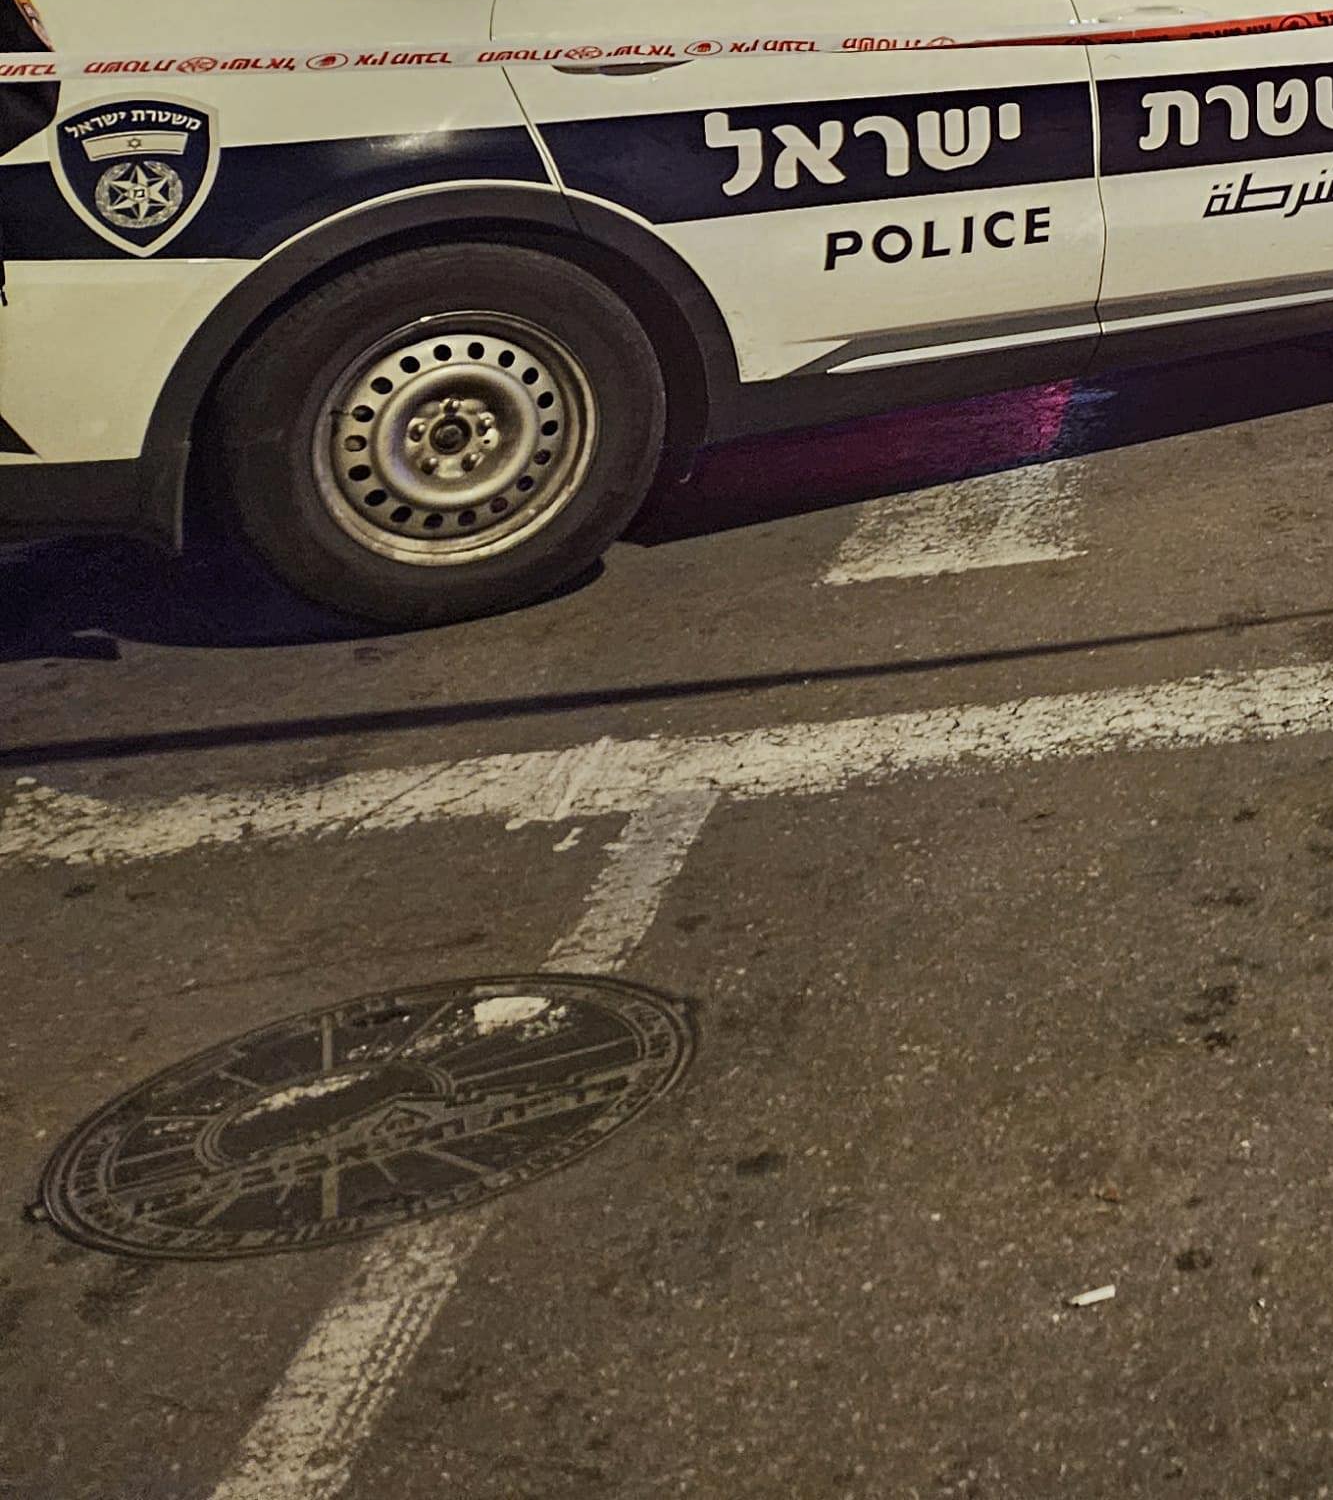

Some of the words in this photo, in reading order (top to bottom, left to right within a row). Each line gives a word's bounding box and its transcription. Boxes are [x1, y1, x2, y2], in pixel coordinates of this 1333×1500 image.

[83, 59, 177, 74] משטרת
[220, 57, 296, 71] ישראל
[353, 51, 390, 67] אין
[390, 51, 452, 65] מעבר
[476, 49, 563, 64] משטרת
[606, 45, 676, 59] ישראל
[728, 39, 758, 53] אין
[762, 40, 821, 52] מעבר
[64, 110, 127, 139] ישראל
[130, 108, 202, 131] משטרת
[703, 101, 1022, 197] ישראל
[823, 205, 1051, 272] POLICE
